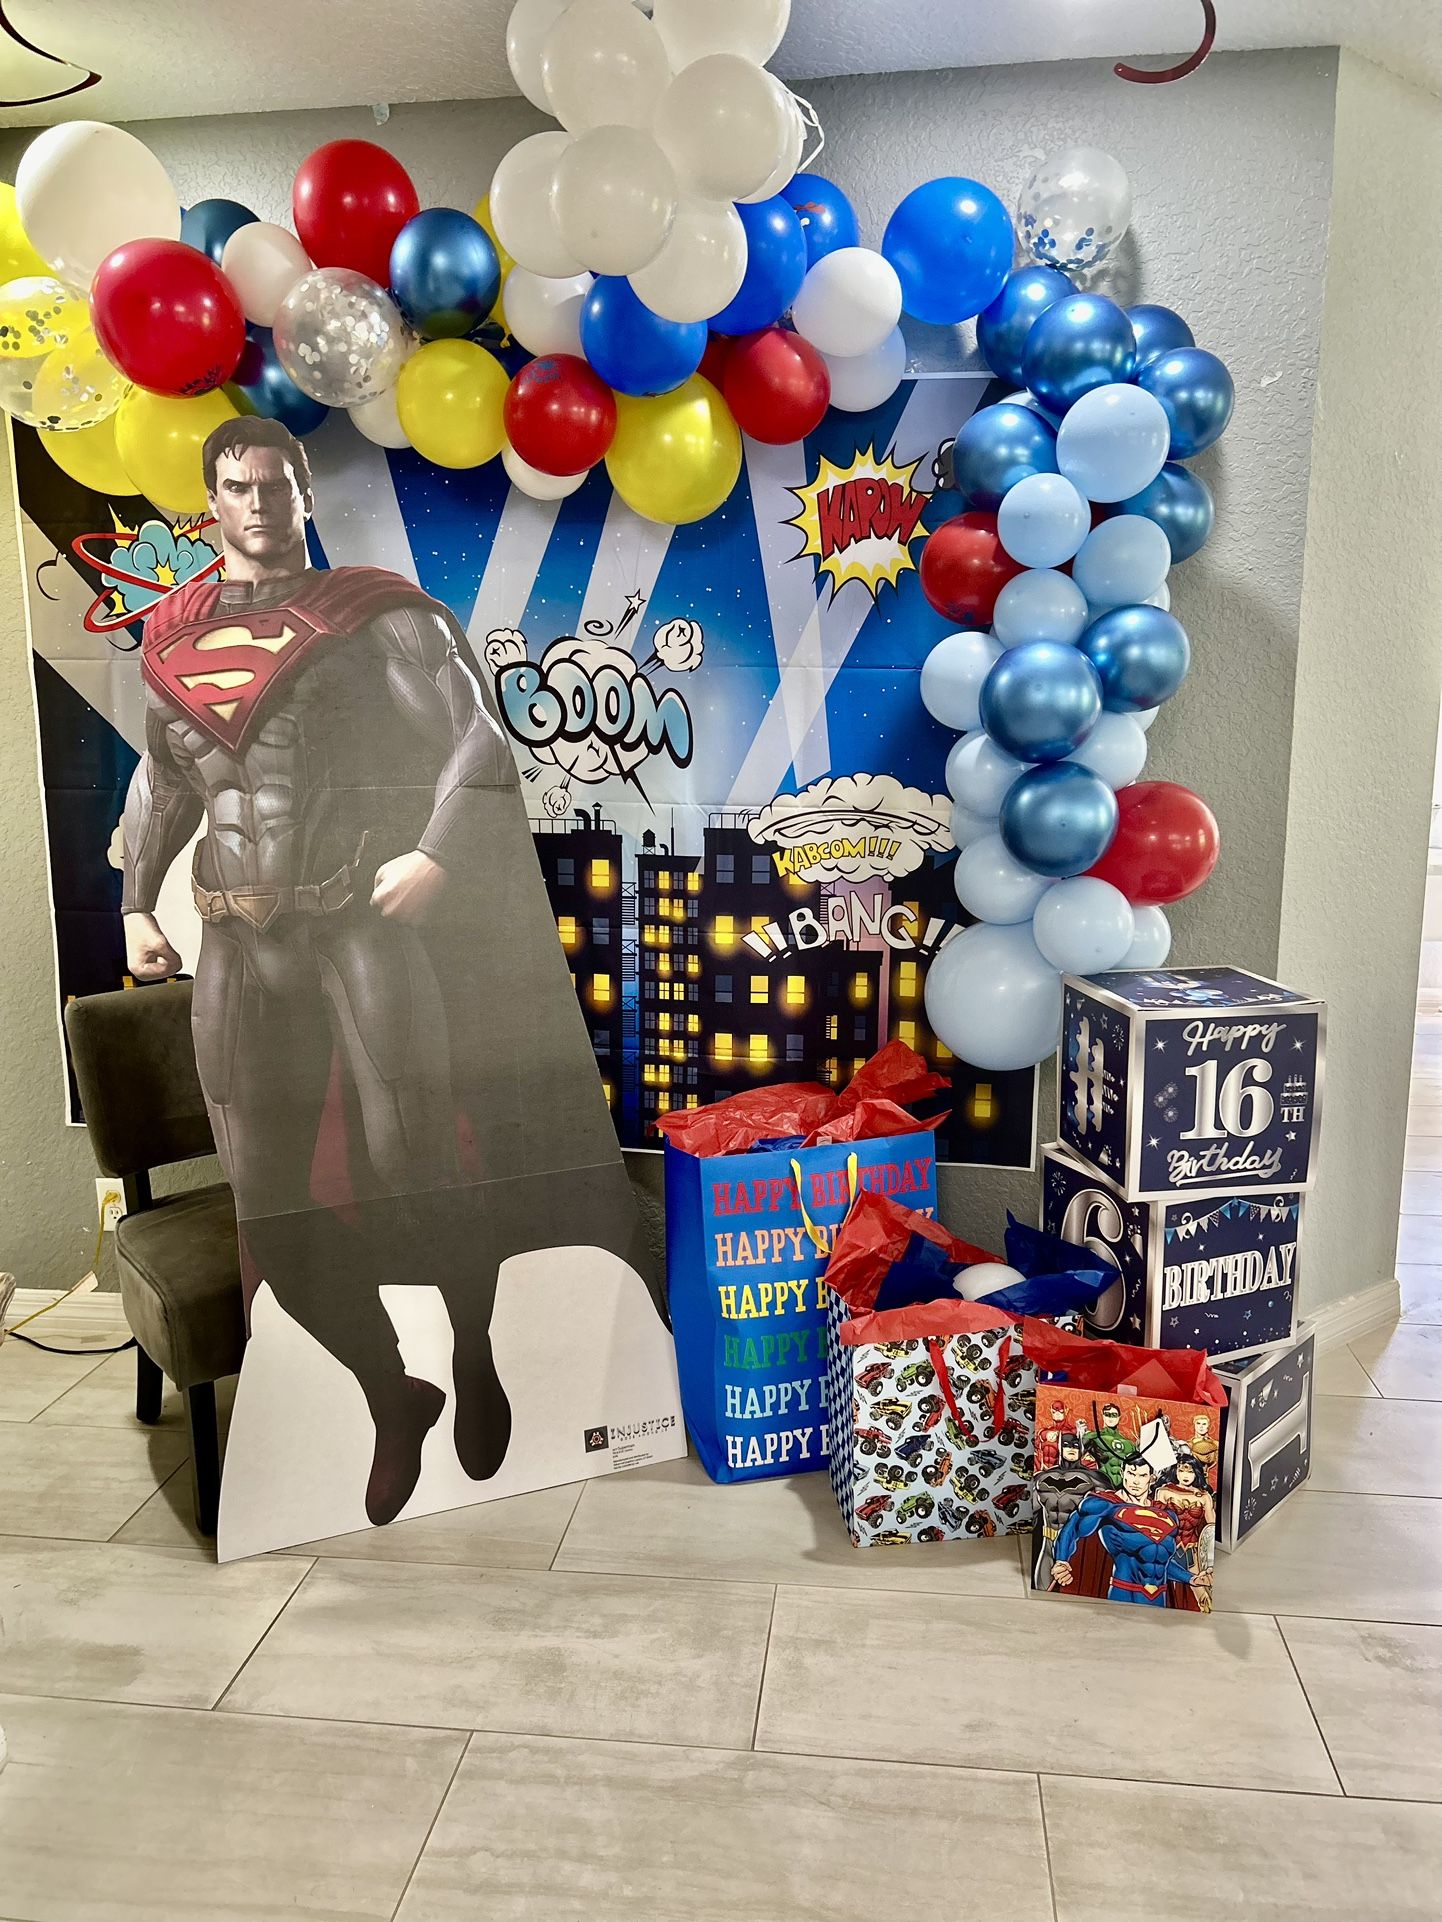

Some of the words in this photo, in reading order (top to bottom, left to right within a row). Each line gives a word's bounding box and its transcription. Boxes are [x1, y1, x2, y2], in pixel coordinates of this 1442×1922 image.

[817, 478, 929, 562] KAPOW
[495, 657, 694, 769] BOOM
[1182, 1020, 1287, 1056] Happy
[1179, 1057, 1274, 1140] 16
[1280, 1107, 1305, 1123] TH
[1166, 1140, 1283, 1183] Birthday
[711, 1176, 802, 1216] HAPPY
[714, 1225, 807, 1267] HAPPY
[1162, 1241, 1297, 1311] BIRTHDAY
[718, 1279, 809, 1320] HAPPY
[723, 1328, 810, 1370] HAPPY
[725, 1379, 813, 1420] HAPPY
[610, 1415, 676, 1440] INJUSTICE
[725, 1429, 814, 1469] HAPPY
